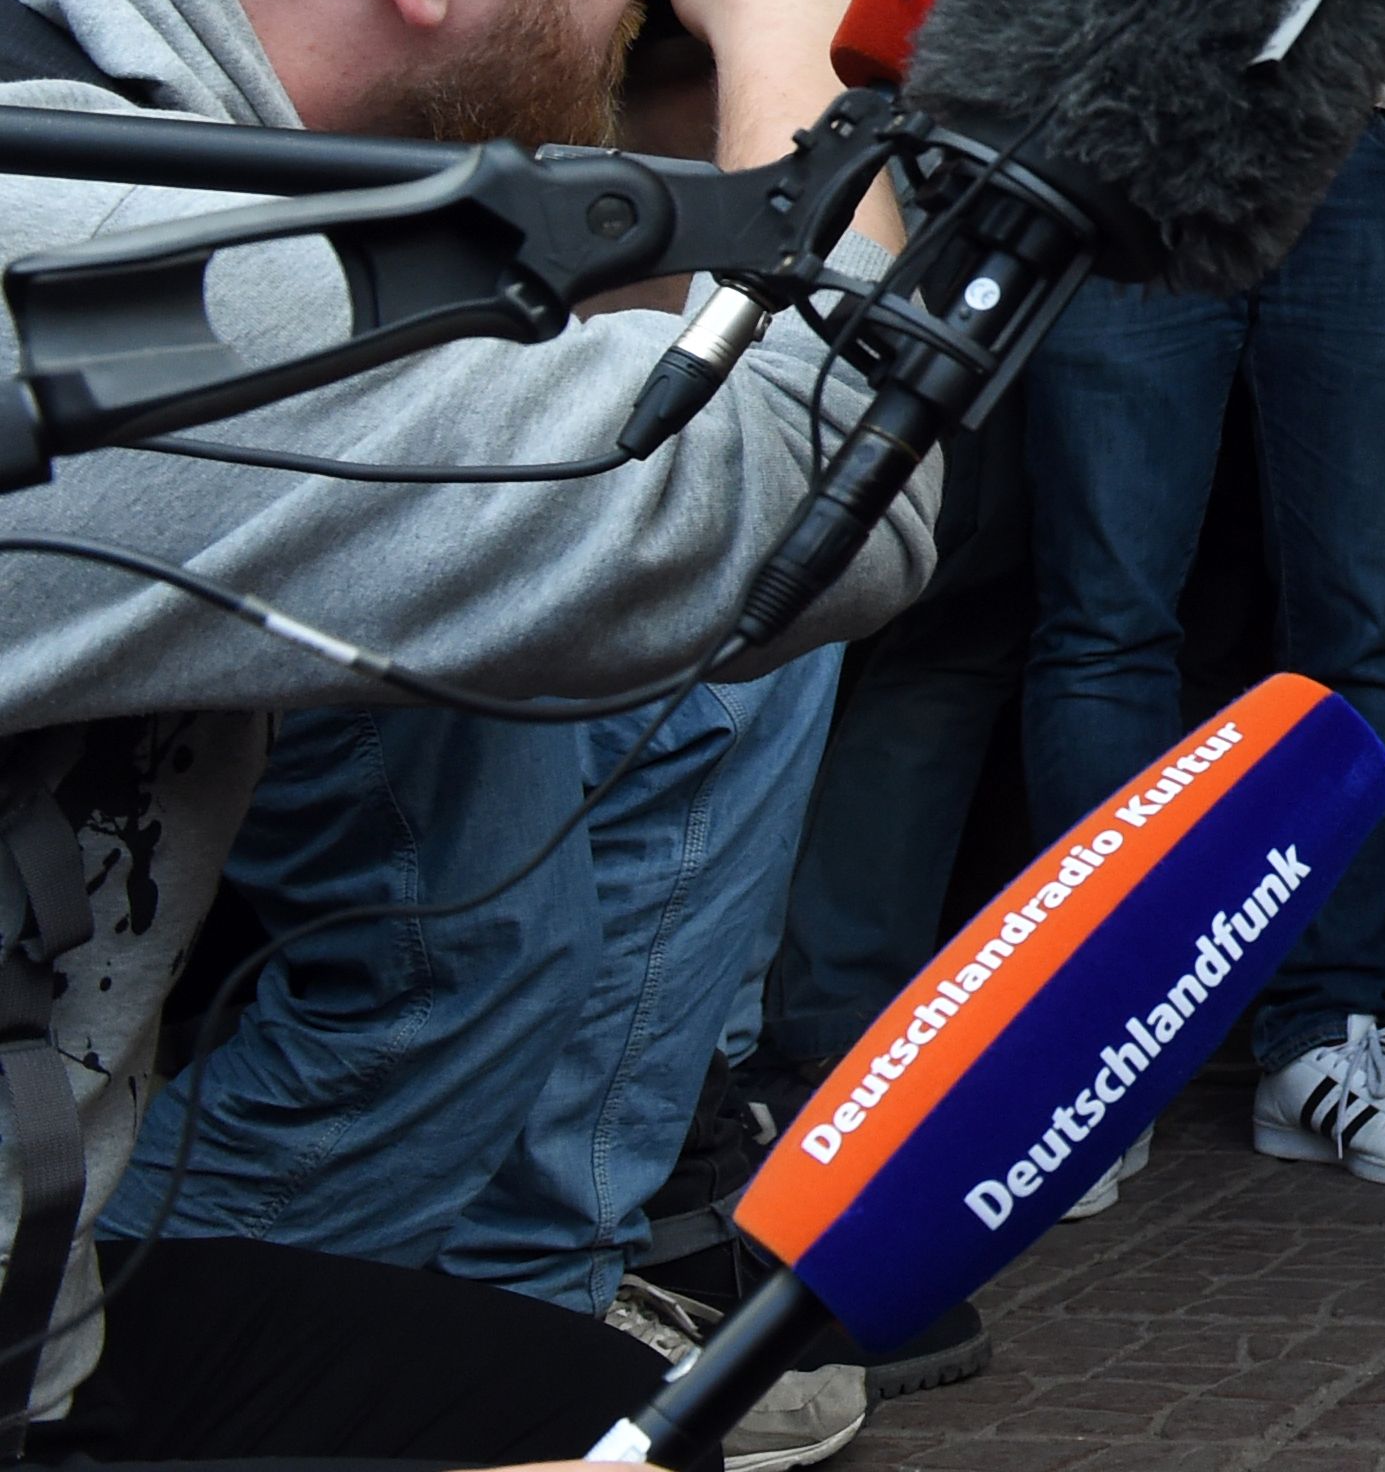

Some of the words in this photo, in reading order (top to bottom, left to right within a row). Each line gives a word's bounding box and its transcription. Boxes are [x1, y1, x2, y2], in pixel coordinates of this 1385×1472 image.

[800, 829, 1124, 1165] Deutschlandradio
[1114, 721, 1243, 828] Kultur
[964, 844, 1312, 1230] Deutschlandfunk
